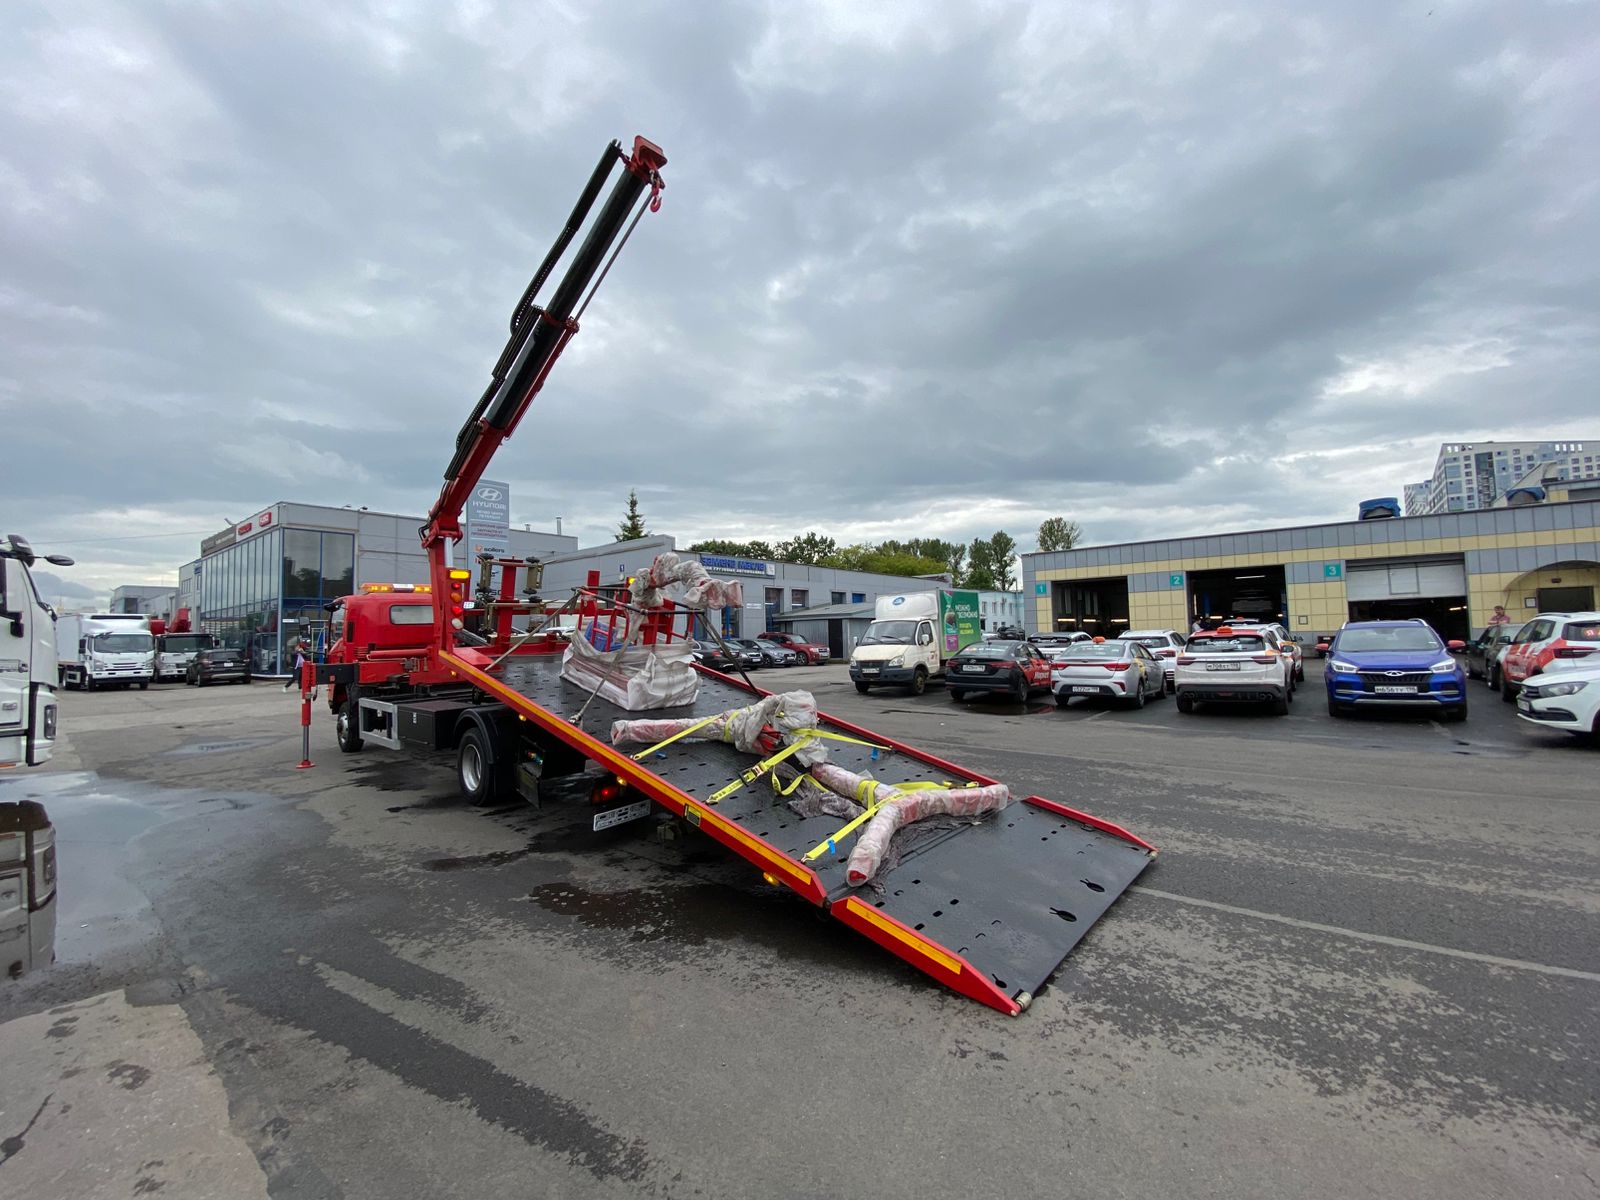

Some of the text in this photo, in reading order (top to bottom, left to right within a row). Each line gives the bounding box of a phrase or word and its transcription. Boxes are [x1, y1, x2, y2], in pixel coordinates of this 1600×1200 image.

[472, 500, 506, 510] HYUNDAI
[1329, 566, 1336, 576] 3
[1174, 576, 1181, 585] 2
